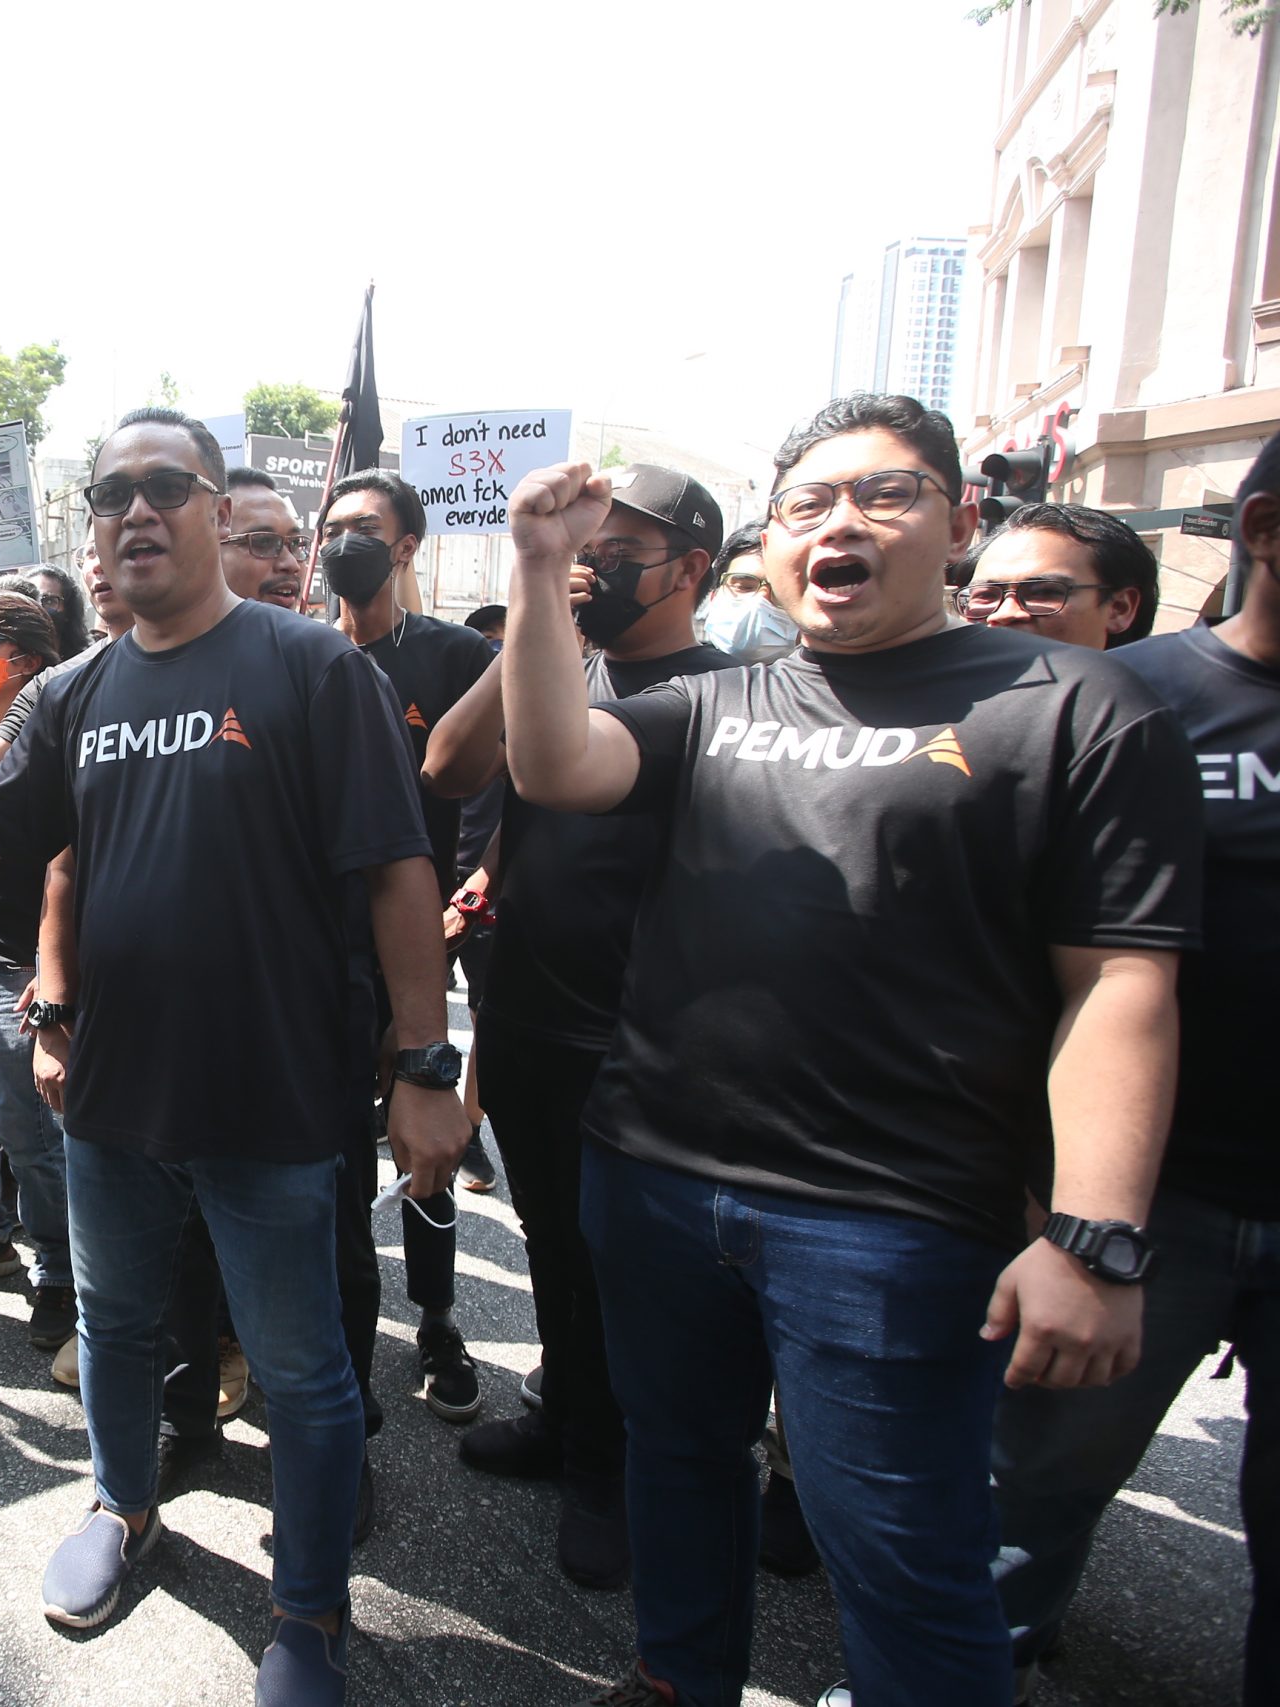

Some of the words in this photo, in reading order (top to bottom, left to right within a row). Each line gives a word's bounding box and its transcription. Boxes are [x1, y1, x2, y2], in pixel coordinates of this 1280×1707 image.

[416, 425, 428, 447] I
[442, 419, 490, 447] don't
[498, 418, 546, 440] need
[265, 456, 327, 476] SPORT
[448, 449, 506, 477] S3X
[413, 484, 467, 507] omen
[473, 478, 508, 503] fck
